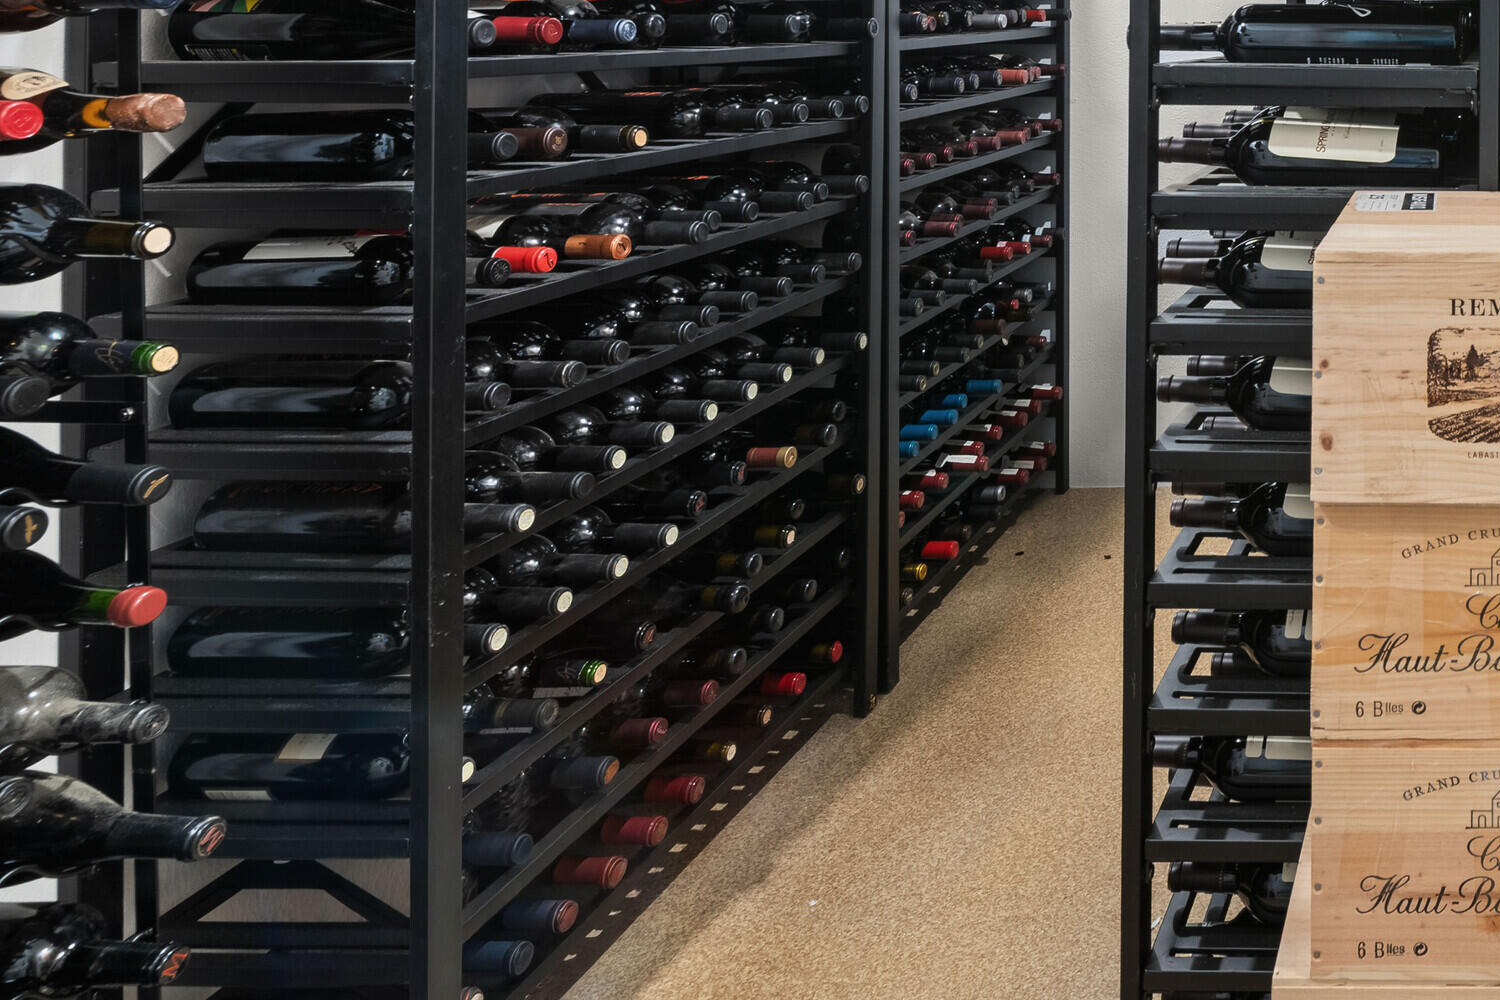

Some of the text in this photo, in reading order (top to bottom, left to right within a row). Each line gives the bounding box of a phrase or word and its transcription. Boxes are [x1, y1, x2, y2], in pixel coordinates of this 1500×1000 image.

[1401, 533, 1460, 561] GRAND
[1355, 701, 1365, 718] 6
[1402, 775, 1461, 802] GRAND
[1357, 942, 1367, 960] 6
